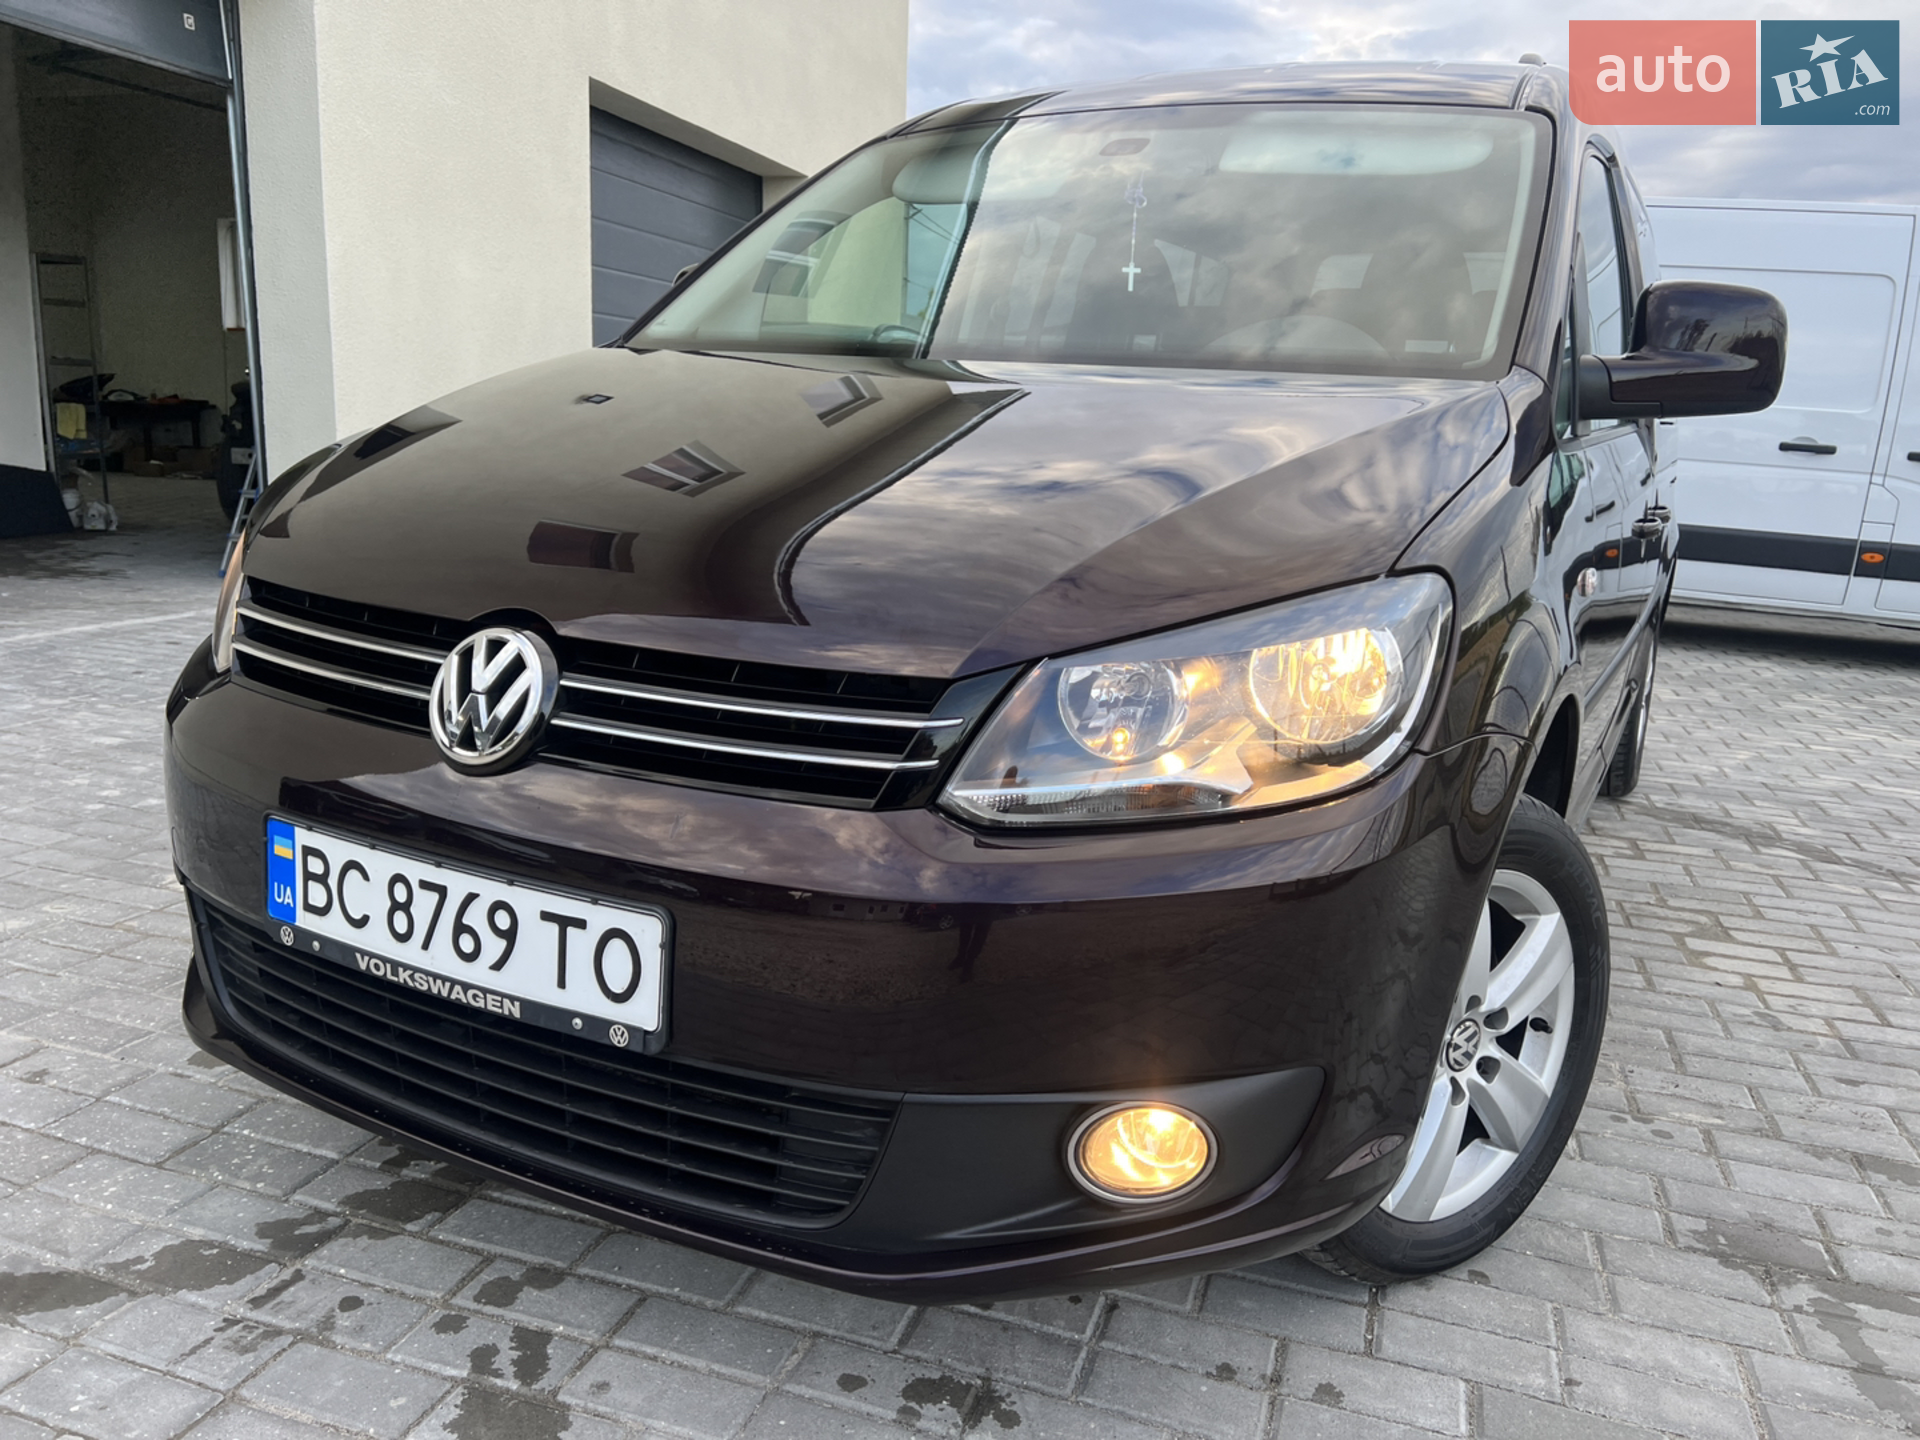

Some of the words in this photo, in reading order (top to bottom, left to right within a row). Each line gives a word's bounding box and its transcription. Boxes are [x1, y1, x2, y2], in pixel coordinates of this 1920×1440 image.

[273, 881, 294, 908] UA
[300, 843, 371, 930] BC
[386, 872, 519, 973] 8769
[539, 910, 642, 1005] TO
[354, 952, 521, 1019] VOLKSWAGEN
